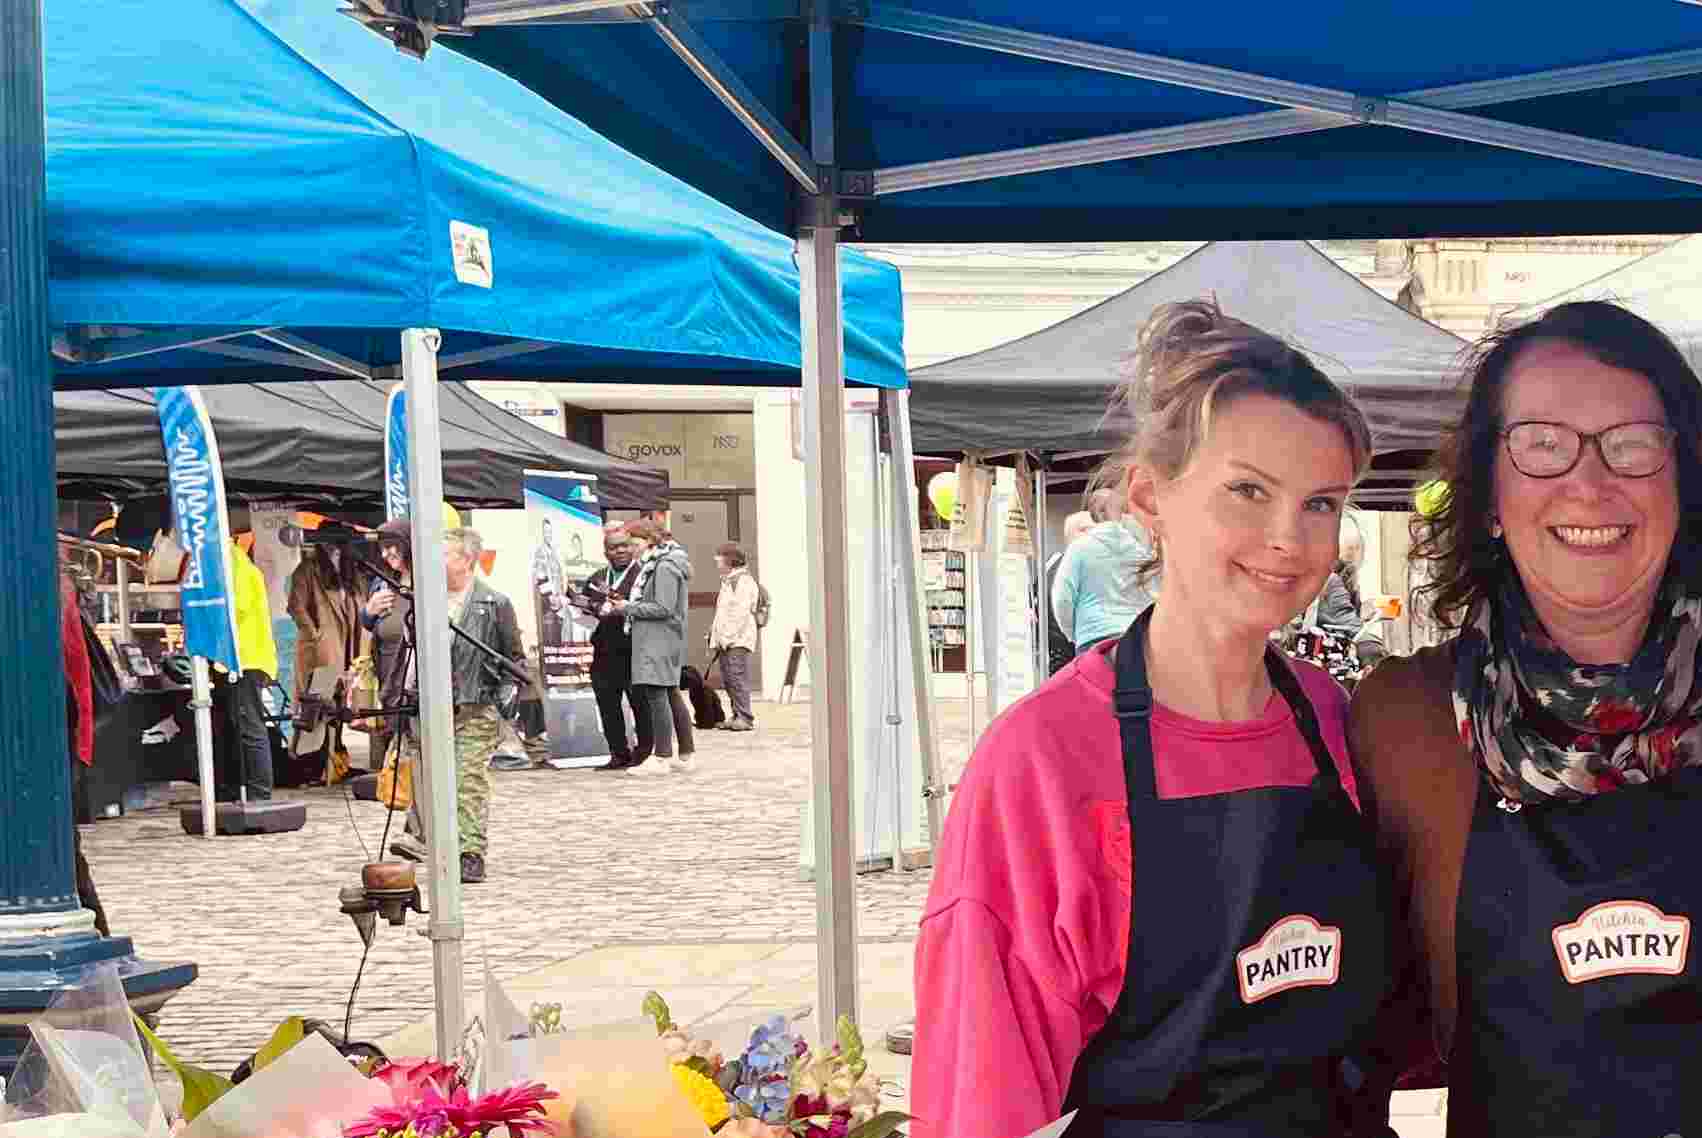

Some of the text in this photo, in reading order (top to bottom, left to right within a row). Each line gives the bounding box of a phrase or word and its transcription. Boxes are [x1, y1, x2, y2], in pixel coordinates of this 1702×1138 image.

[628, 443, 682, 460] govox
[1245, 943, 1333, 987] PANTRY
[1565, 933, 1682, 966] PANTRY
